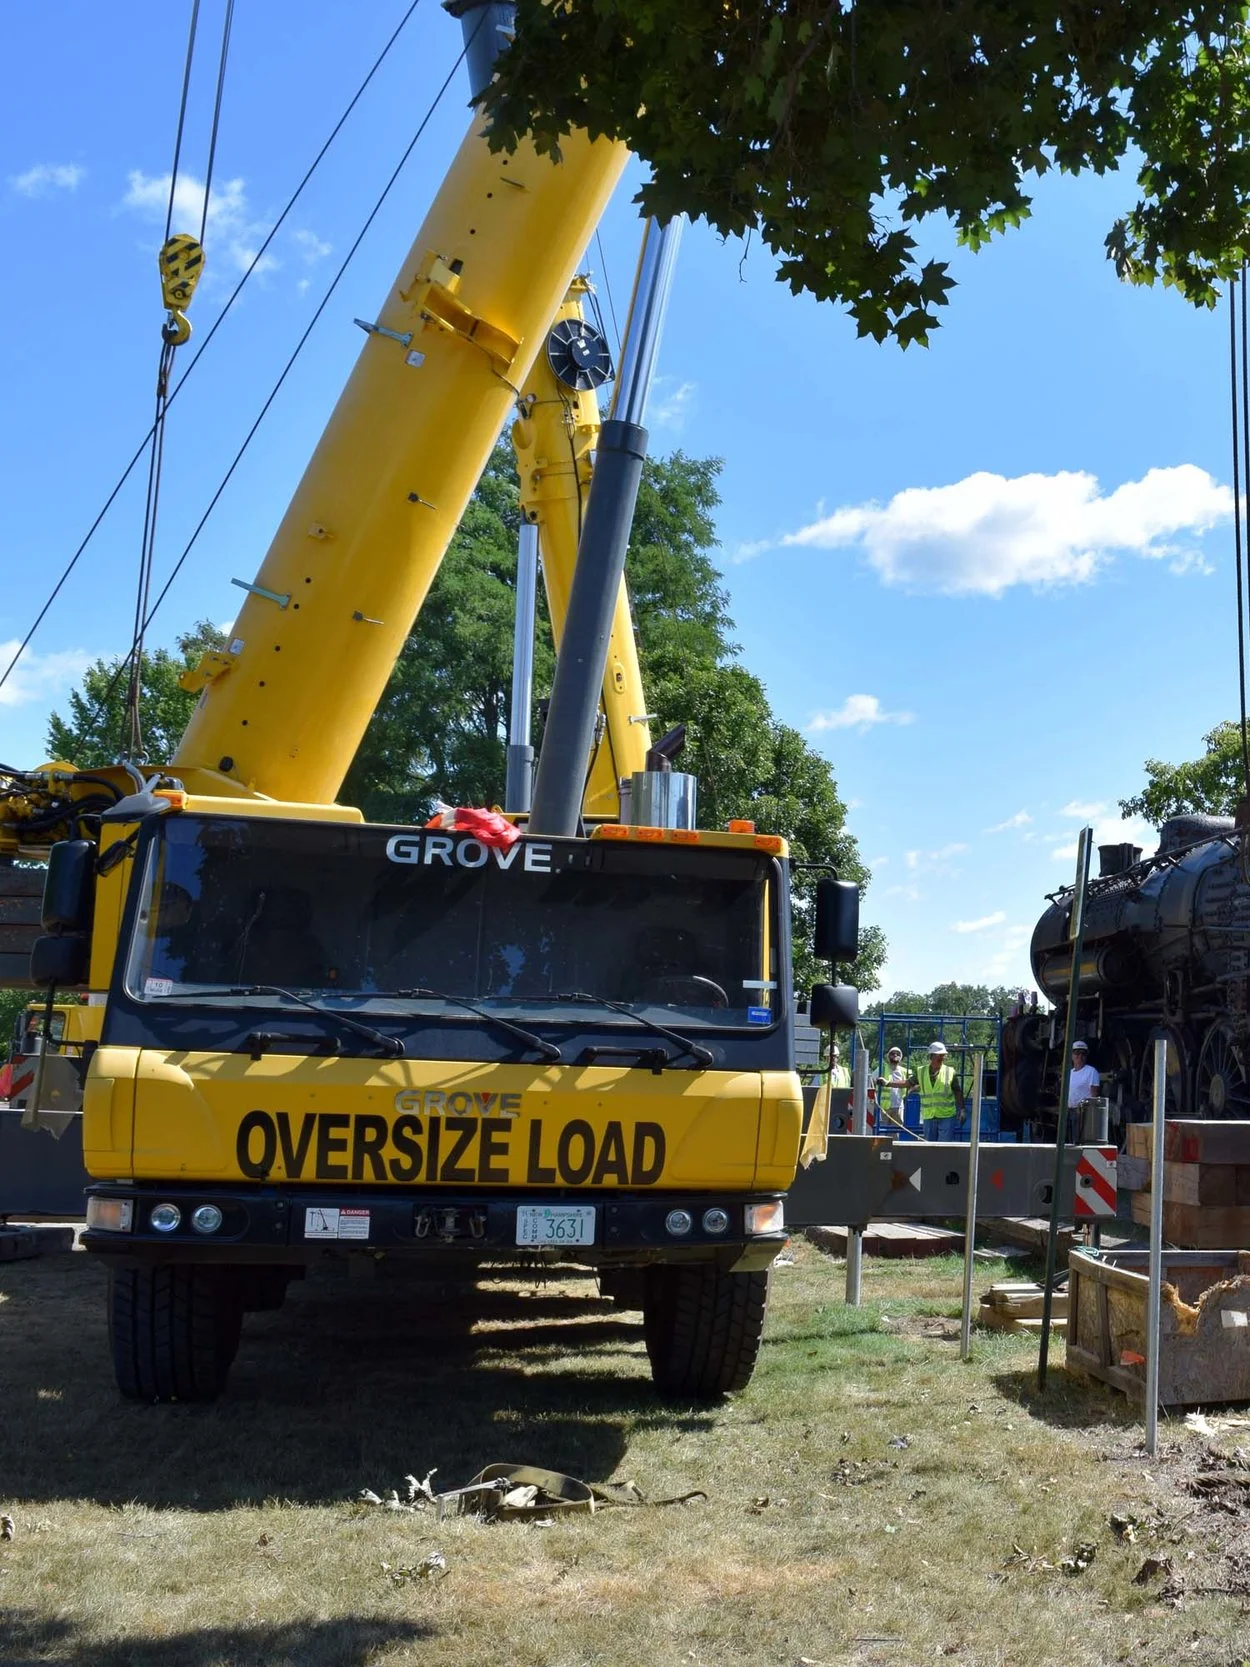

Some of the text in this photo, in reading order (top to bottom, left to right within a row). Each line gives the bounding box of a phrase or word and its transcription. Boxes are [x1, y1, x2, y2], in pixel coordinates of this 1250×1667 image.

[386, 834, 553, 874] GROVE
[395, 1089, 522, 1119] GROVE
[236, 1110, 667, 1186] OVERSIZE LOAD
[545, 1218, 584, 1239] 3631
